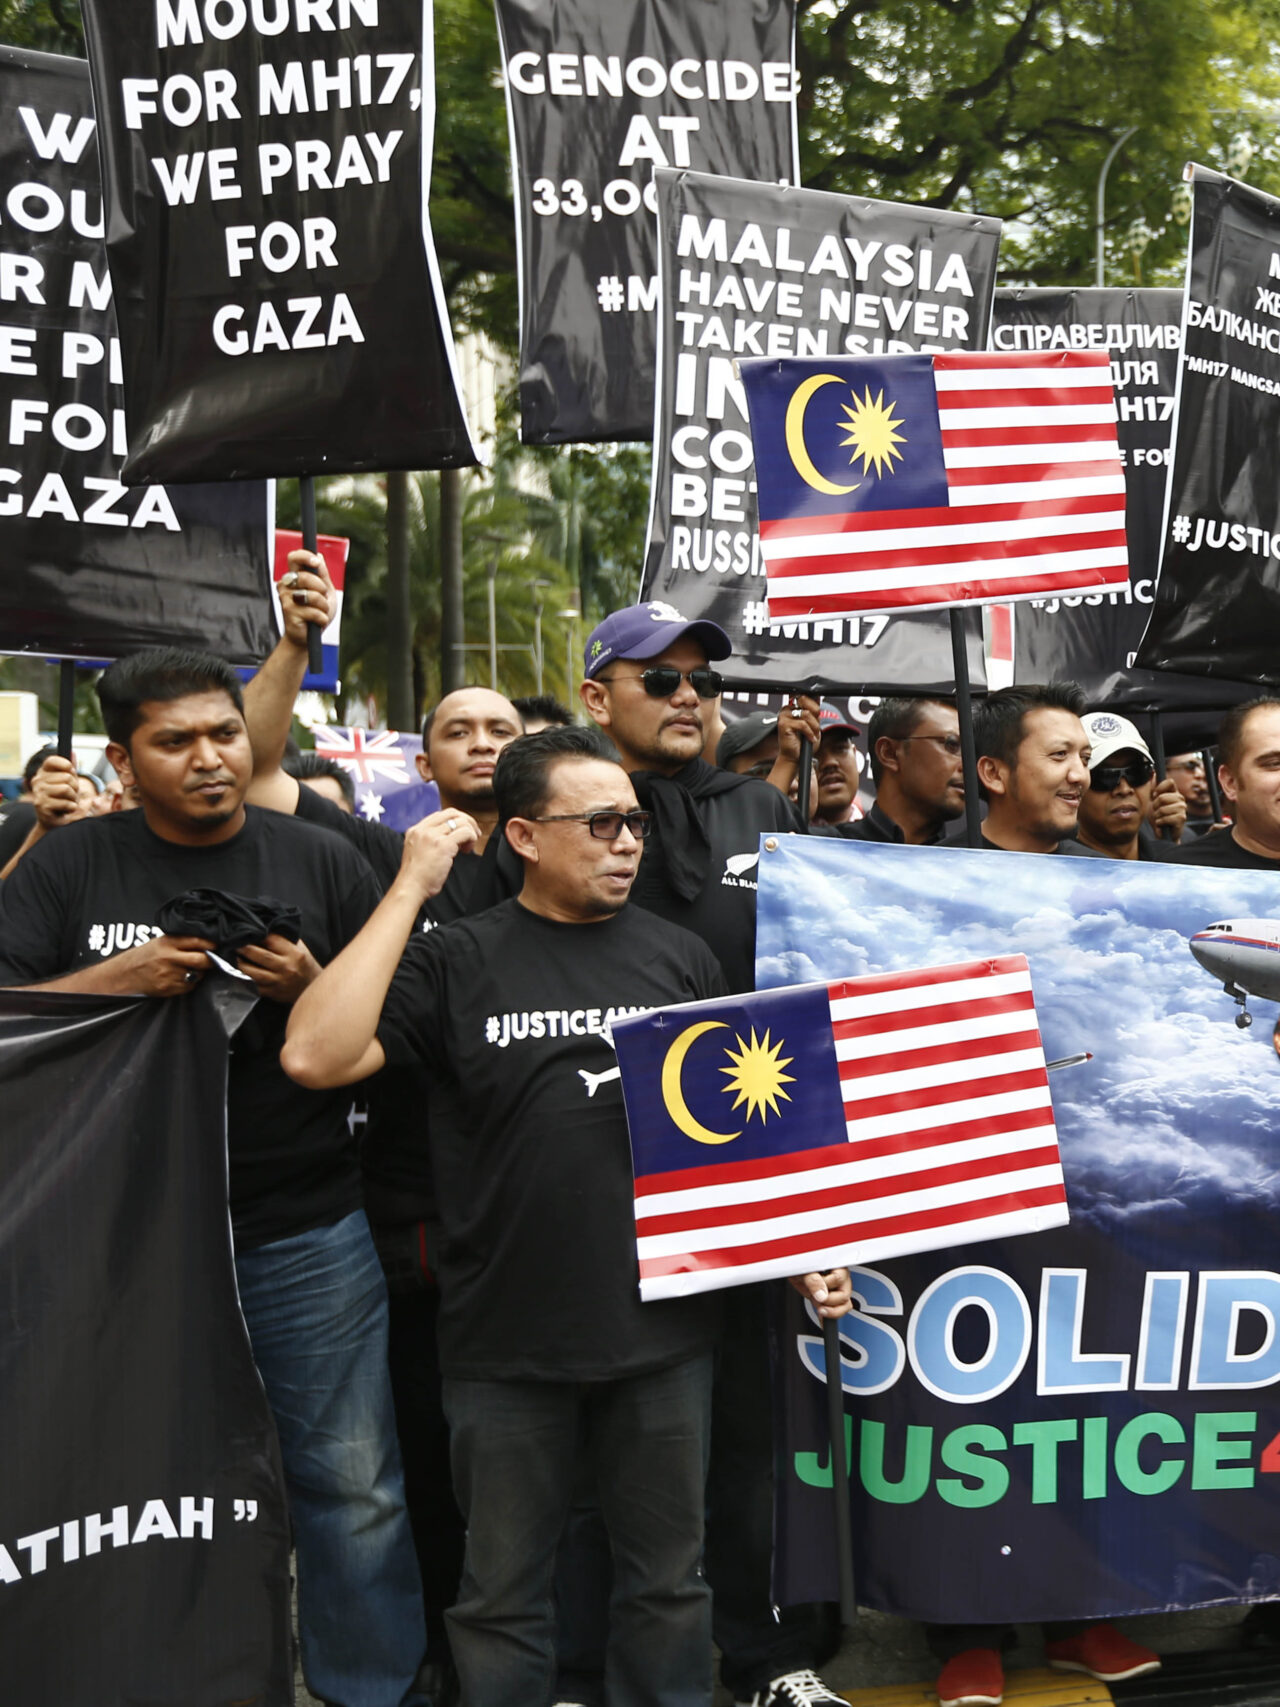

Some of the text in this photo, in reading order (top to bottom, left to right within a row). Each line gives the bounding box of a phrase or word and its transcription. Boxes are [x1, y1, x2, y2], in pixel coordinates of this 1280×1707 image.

[122, 53, 422, 130] FOR MH17,
[507, 51, 793, 102] GENOCIDE
[152, 130, 403, 206] WE PRAY
[618, 115, 699, 168] AT
[532, 178, 659, 222] 33,0
[225, 217, 339, 278] FOR
[676, 214, 974, 297] MALAYSIA
[213, 293, 365, 356] GAZA
[679, 268, 803, 318] HAVE
[819, 287, 970, 341] NEVER
[675, 311, 829, 356] TAKEN
[994, 323, 1181, 353] СПРАВЕДЛИВ
[671, 525, 767, 577] RUSSI
